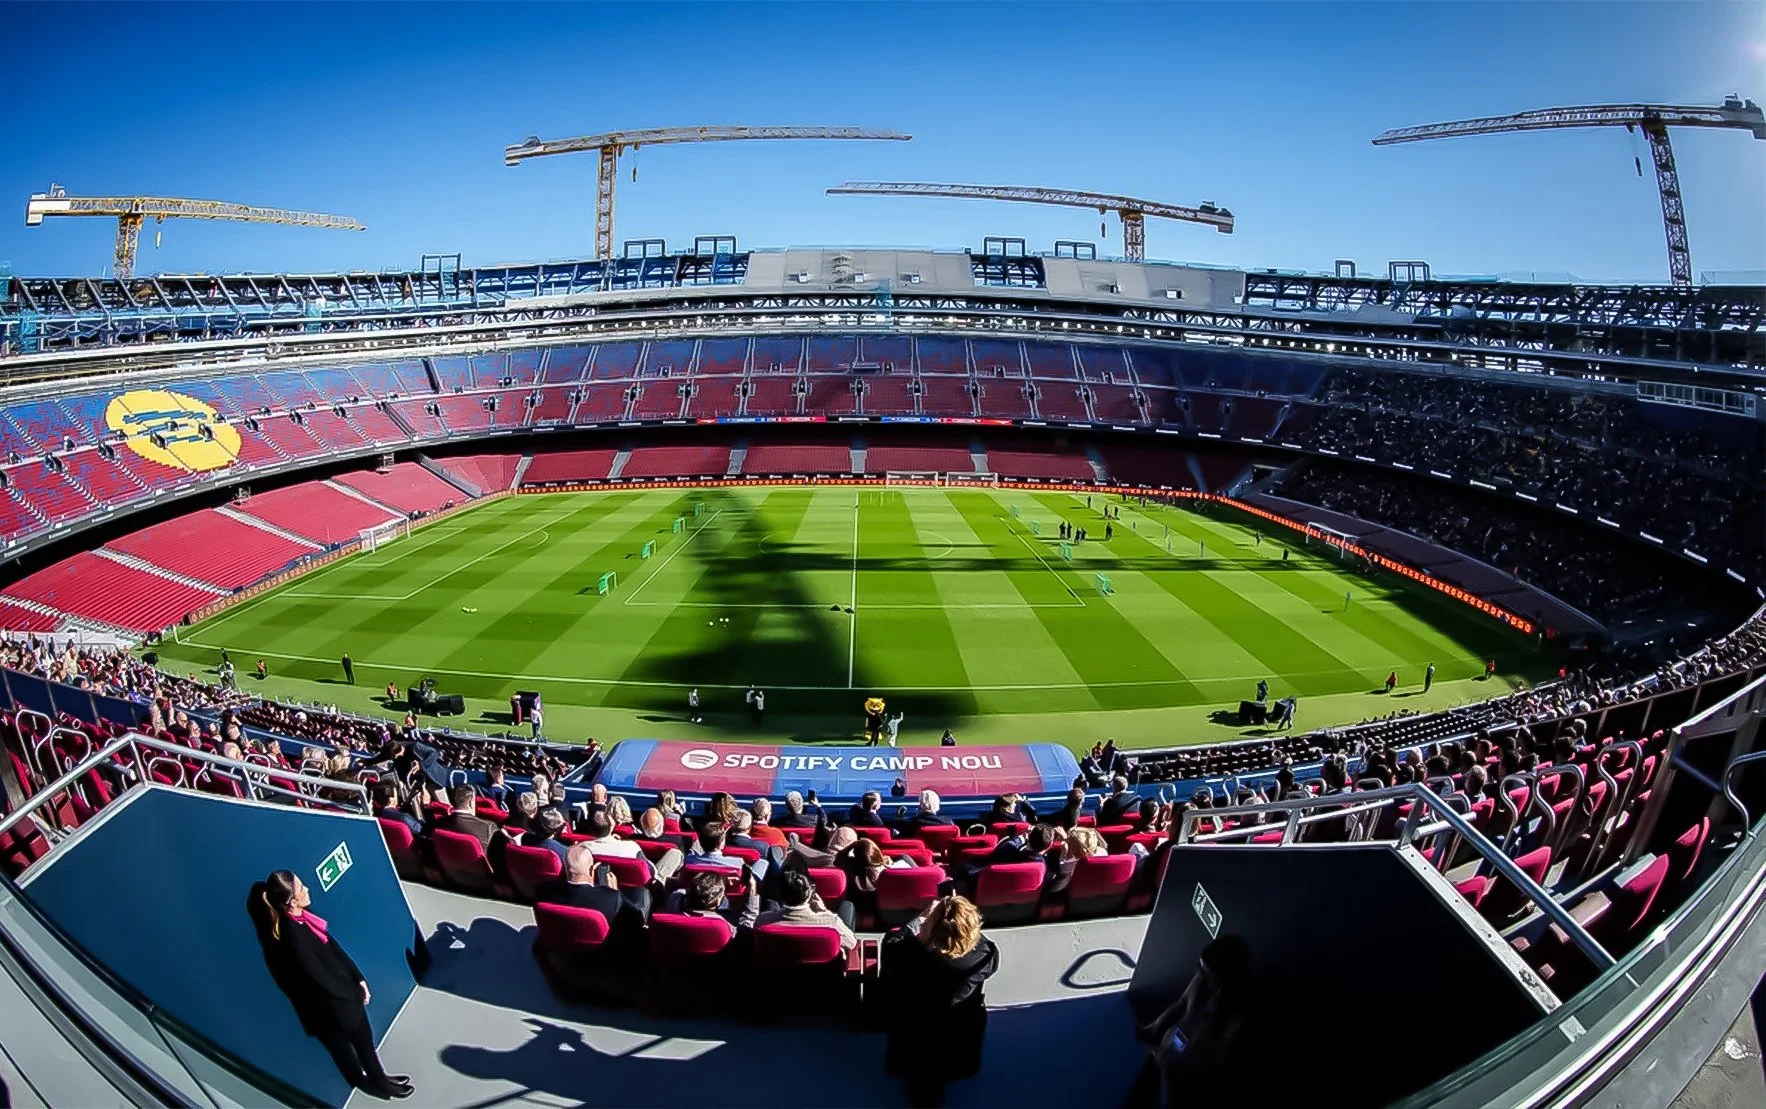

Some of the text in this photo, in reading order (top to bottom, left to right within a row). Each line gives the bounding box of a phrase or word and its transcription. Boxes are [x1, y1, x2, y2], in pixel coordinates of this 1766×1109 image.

[723, 754, 1002, 771] SPOTIFY CAMP NOU
